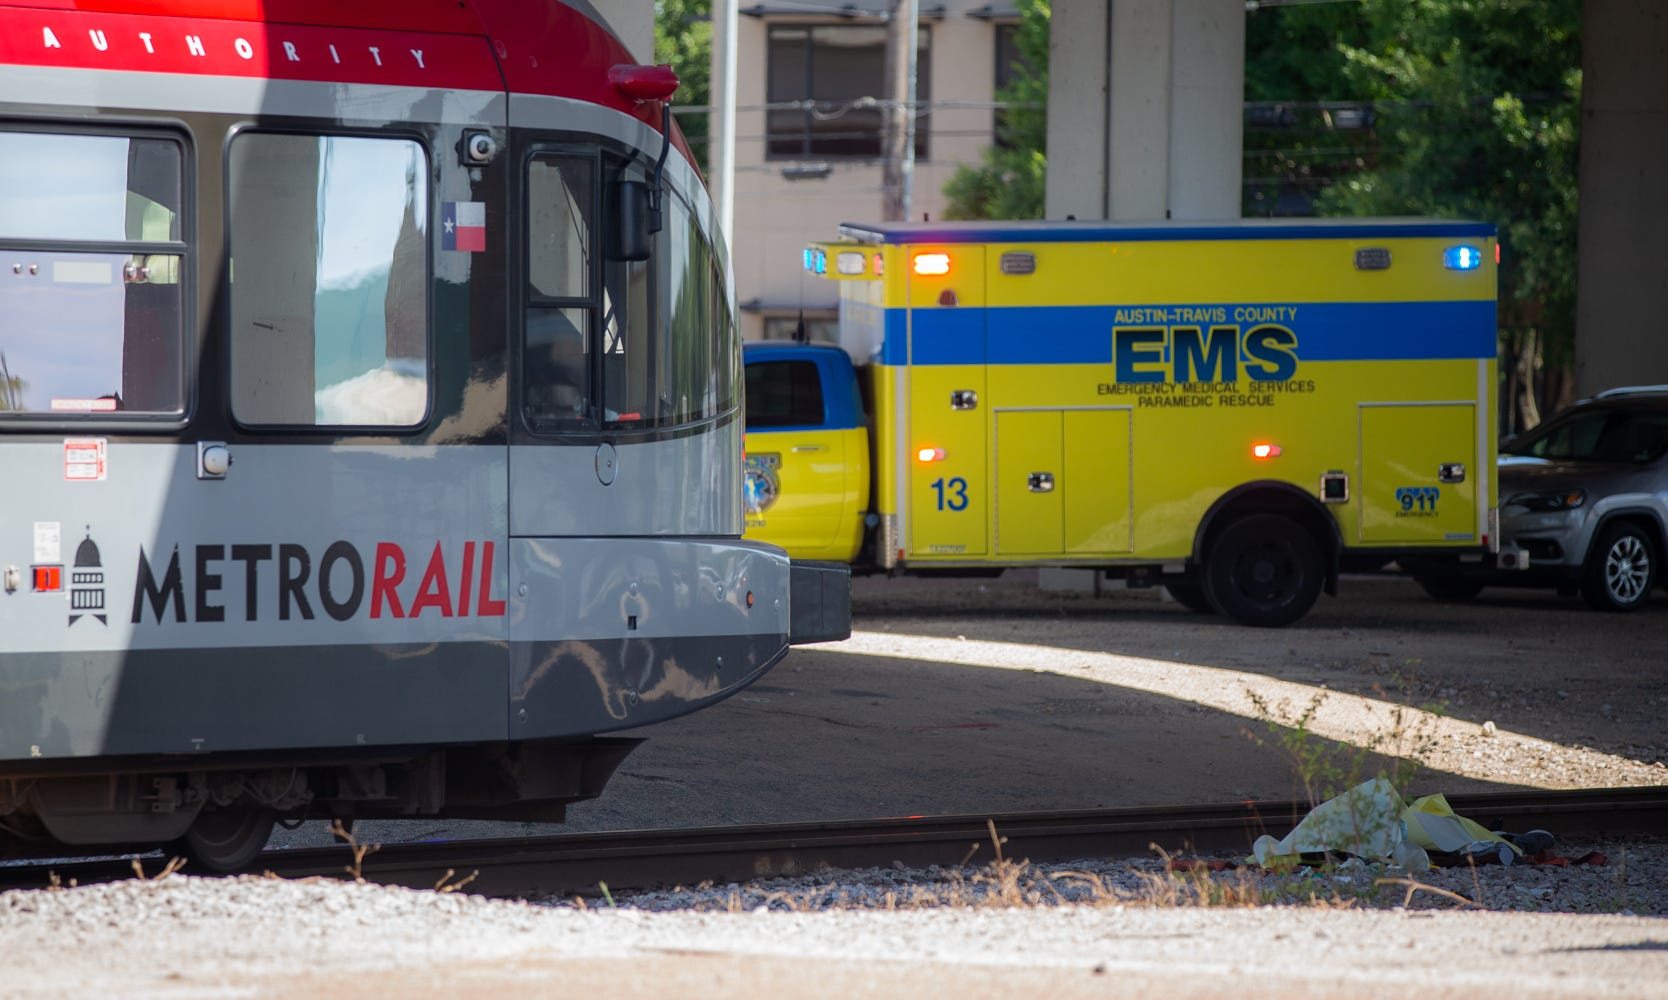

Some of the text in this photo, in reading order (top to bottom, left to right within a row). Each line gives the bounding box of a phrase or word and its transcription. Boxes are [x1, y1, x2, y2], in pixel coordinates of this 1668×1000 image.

[42, 26, 426, 69] AUTHORITY
[1114, 307, 1298, 323] AUSTIN-TRAVIS COUNTY
[1112, 324, 1300, 384] EMS
[1097, 380, 1316, 395] EMERGENCY MEDICAL SERVICES
[1138, 394, 1275, 407] PARAMEDIC RESCUE
[930, 477, 969, 512] 13
[1401, 493, 1436, 512] 911
[131, 540, 506, 626] METRORAIL
